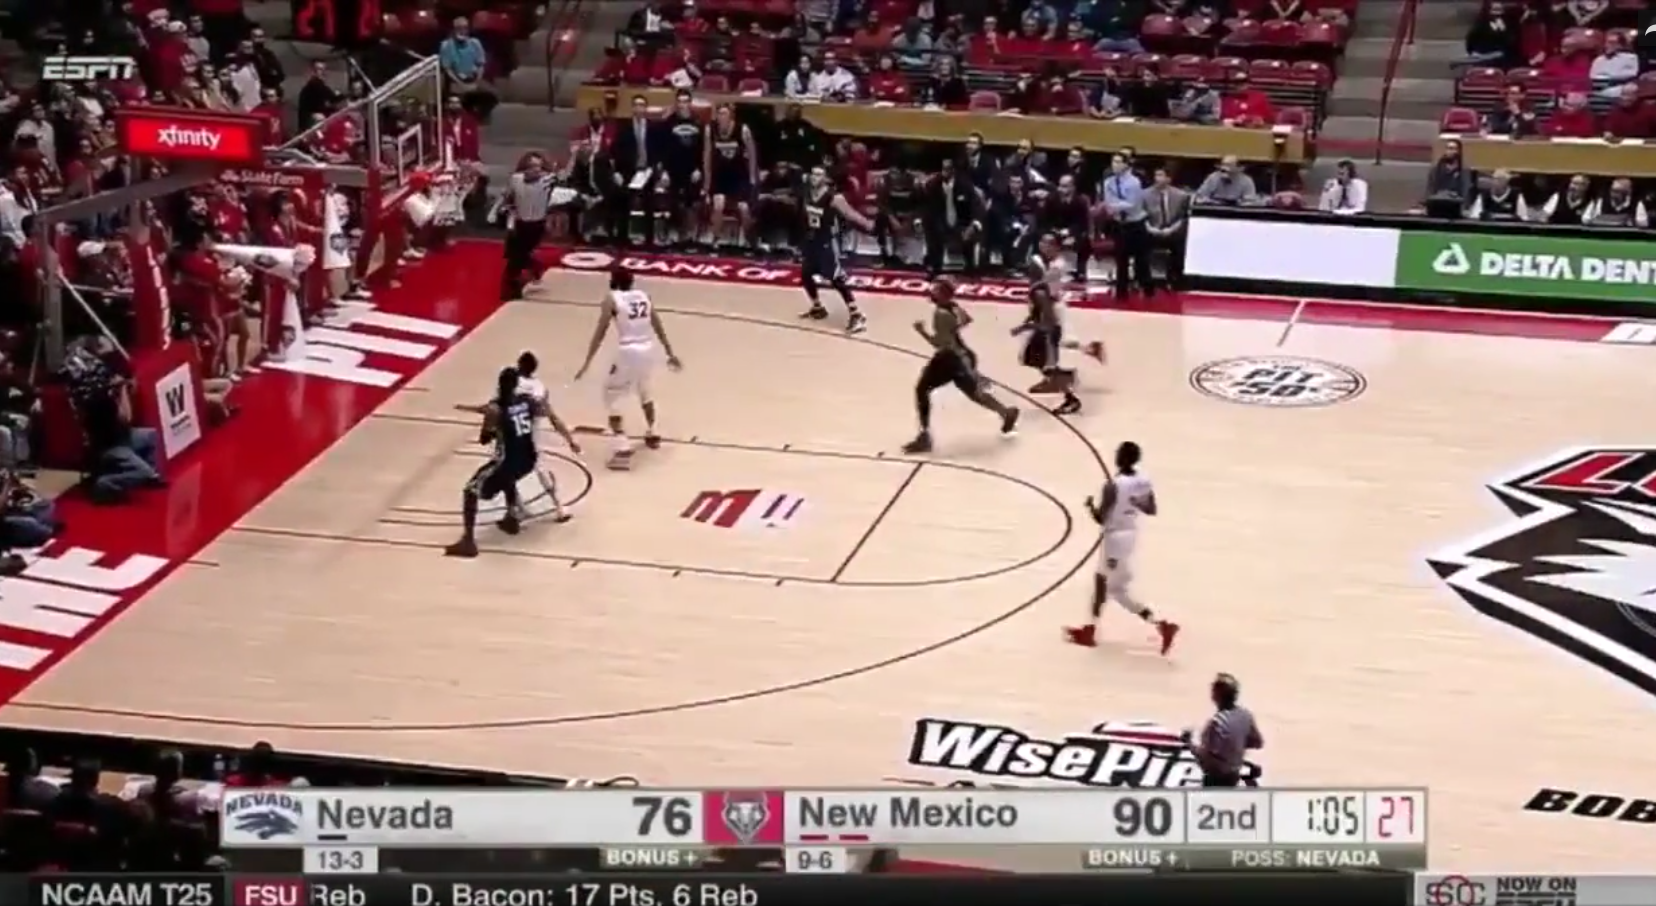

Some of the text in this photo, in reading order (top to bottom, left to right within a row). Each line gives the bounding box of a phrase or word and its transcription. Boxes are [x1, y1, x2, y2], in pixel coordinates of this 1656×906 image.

[157, 124, 221, 151] xfinity
[619, 257, 727, 278] BANK
[737, 267, 793, 283] OF
[1480, 252, 1575, 281] DELTA
[627, 302, 649, 320] 32
[260, 299, 463, 388] PIT
[510, 412, 531, 437] 15
[908, 718, 1263, 788] WisePie
